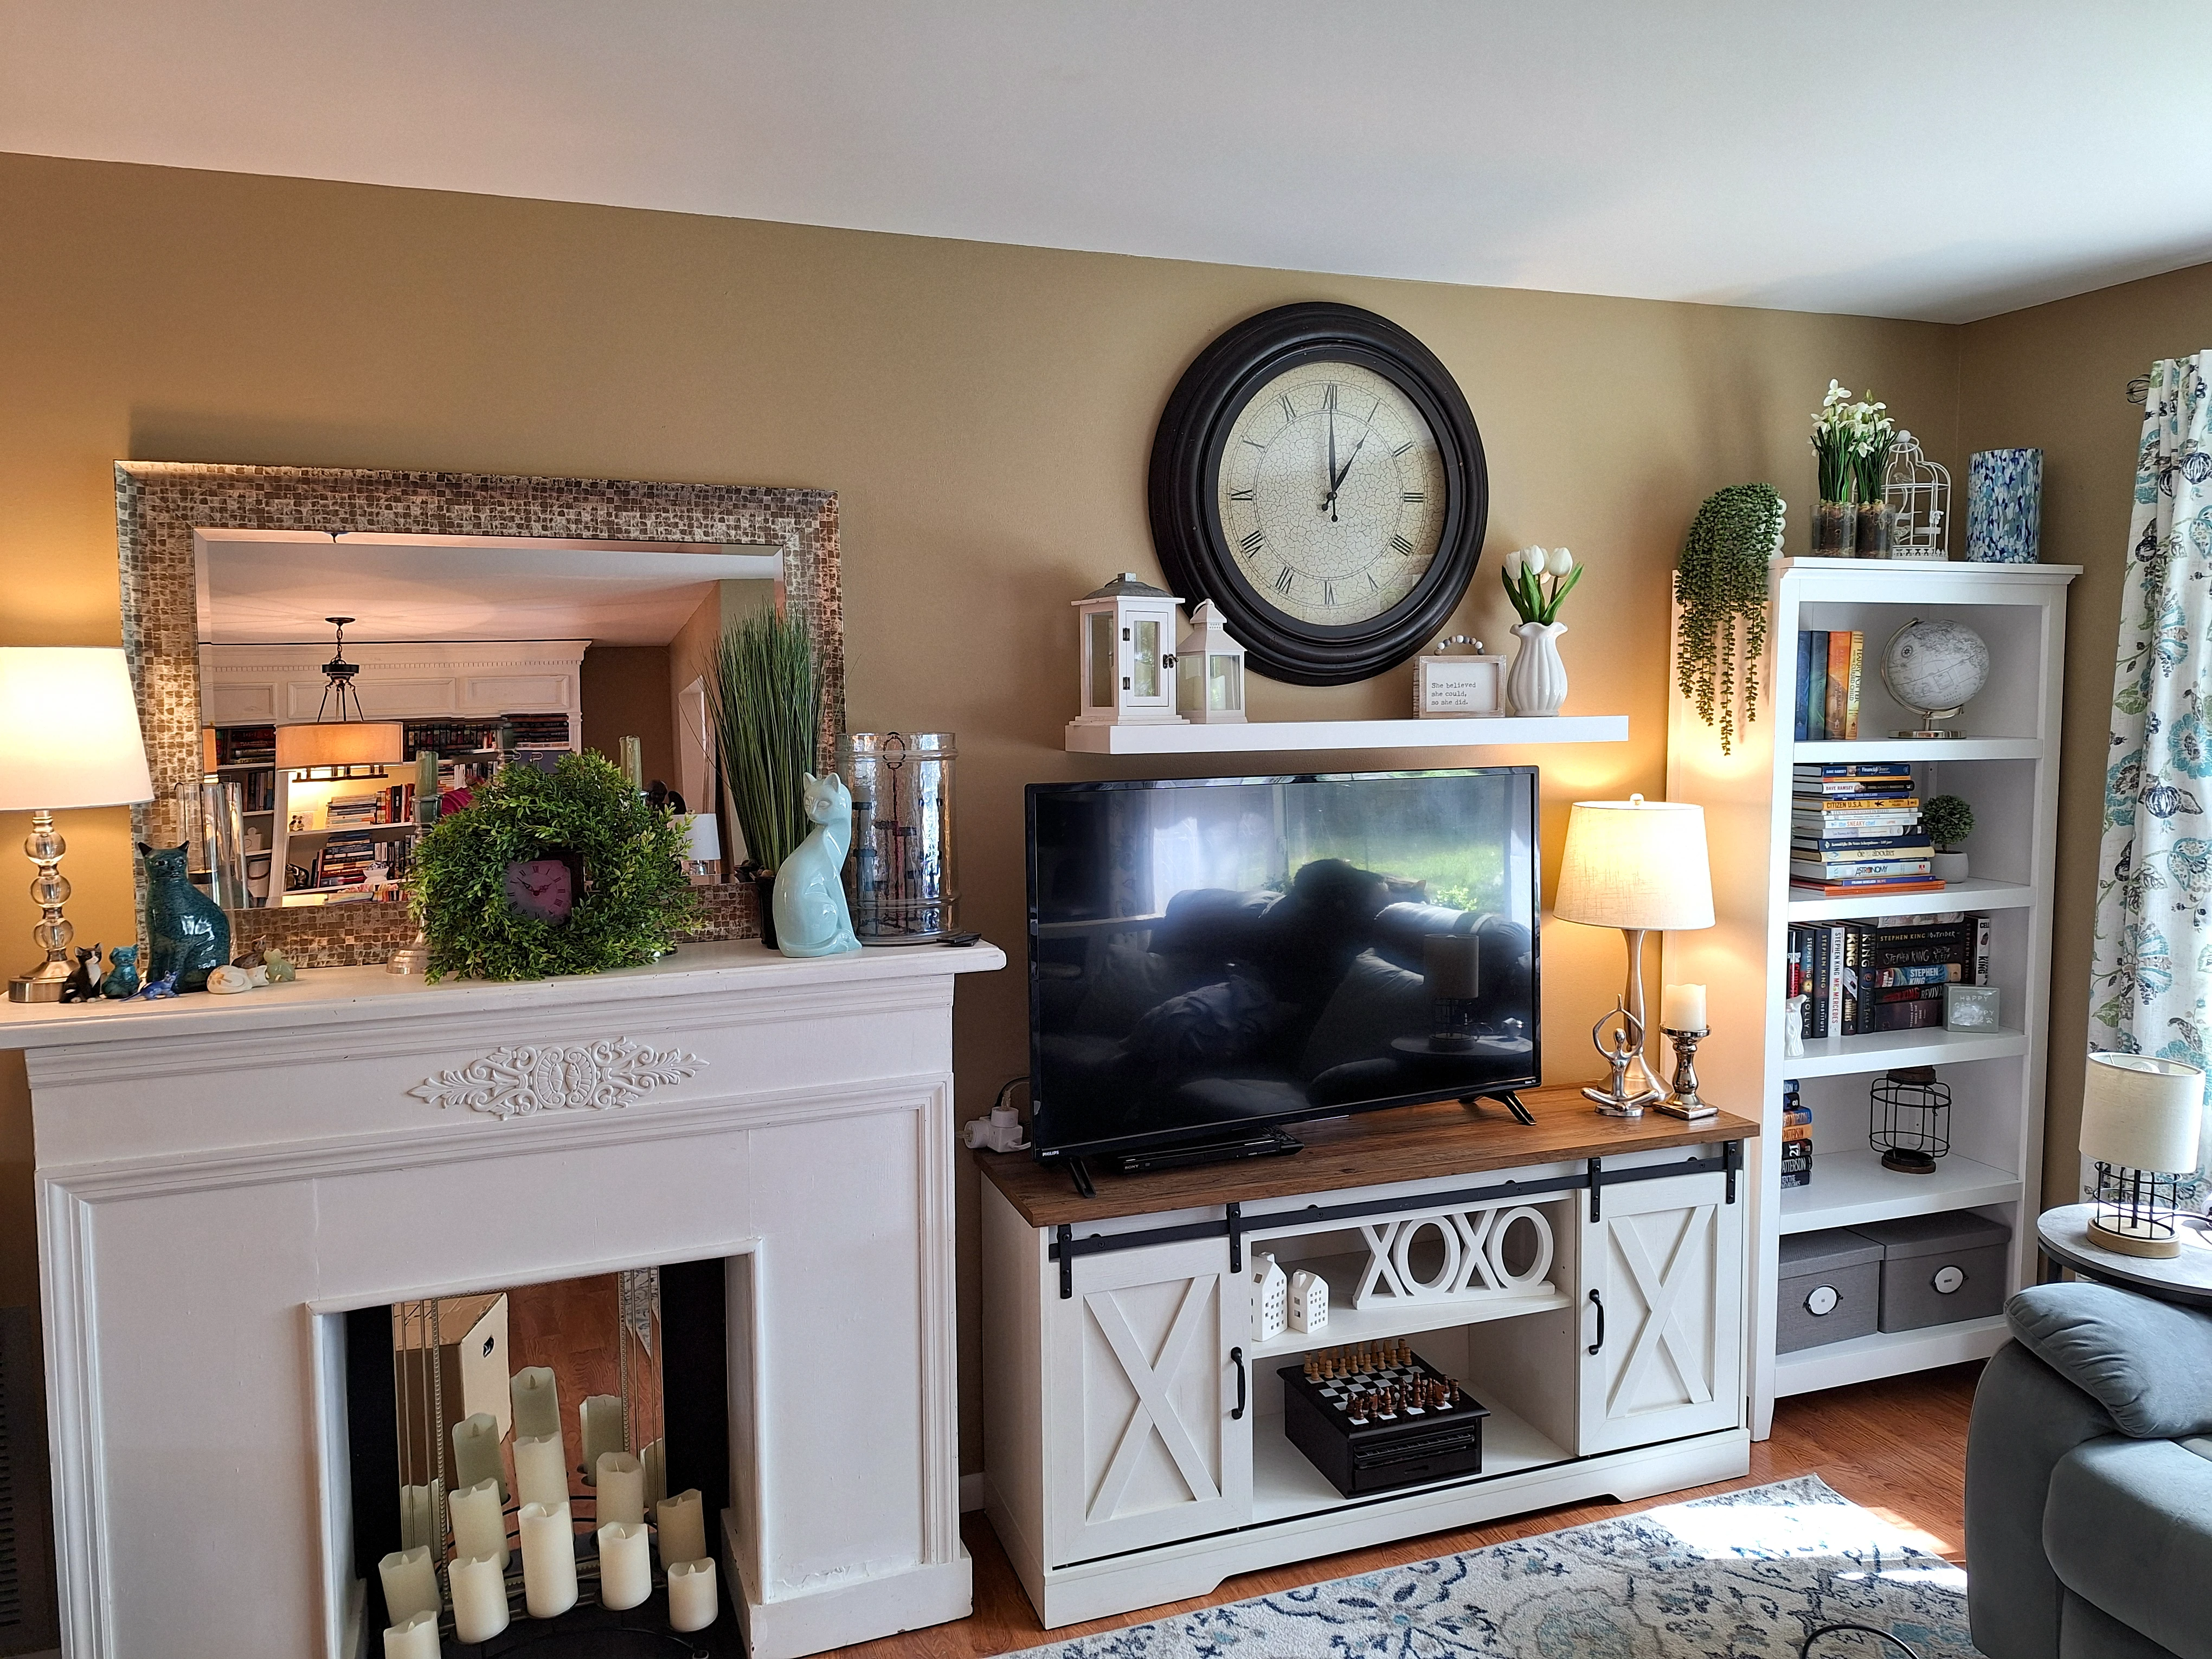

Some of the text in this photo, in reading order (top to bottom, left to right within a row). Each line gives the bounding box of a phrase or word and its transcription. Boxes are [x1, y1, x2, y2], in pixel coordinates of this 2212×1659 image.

[1393, 441, 1414, 458] II
[1403, 491, 1424, 503] III
[1366, 571, 1379, 592] V
[1324, 580, 1335, 605] VI
[1857, 850, 1866, 858] de
[1855, 865, 1888, 877] ASTRONOMY
[1846, 933, 1855, 967] KING
[1861, 934, 1872, 967] KING
[1883, 949, 1930, 965] STEPHEN KING
[1910, 967, 1939, 978] STEPHEN
[1977, 956, 1986, 974] KING
[1881, 971, 1889, 987] DUMA
[1908, 977, 1925, 985] KING
[1831, 992, 1840, 1024] MERCEDES
[1844, 999, 1853, 1021] SUMMERS
[1783, 1127, 1804, 1142] PATTERSON
[1782, 1156, 1806, 1173] ATTERSON
[1353, 1206, 1555, 1307] XOXO
